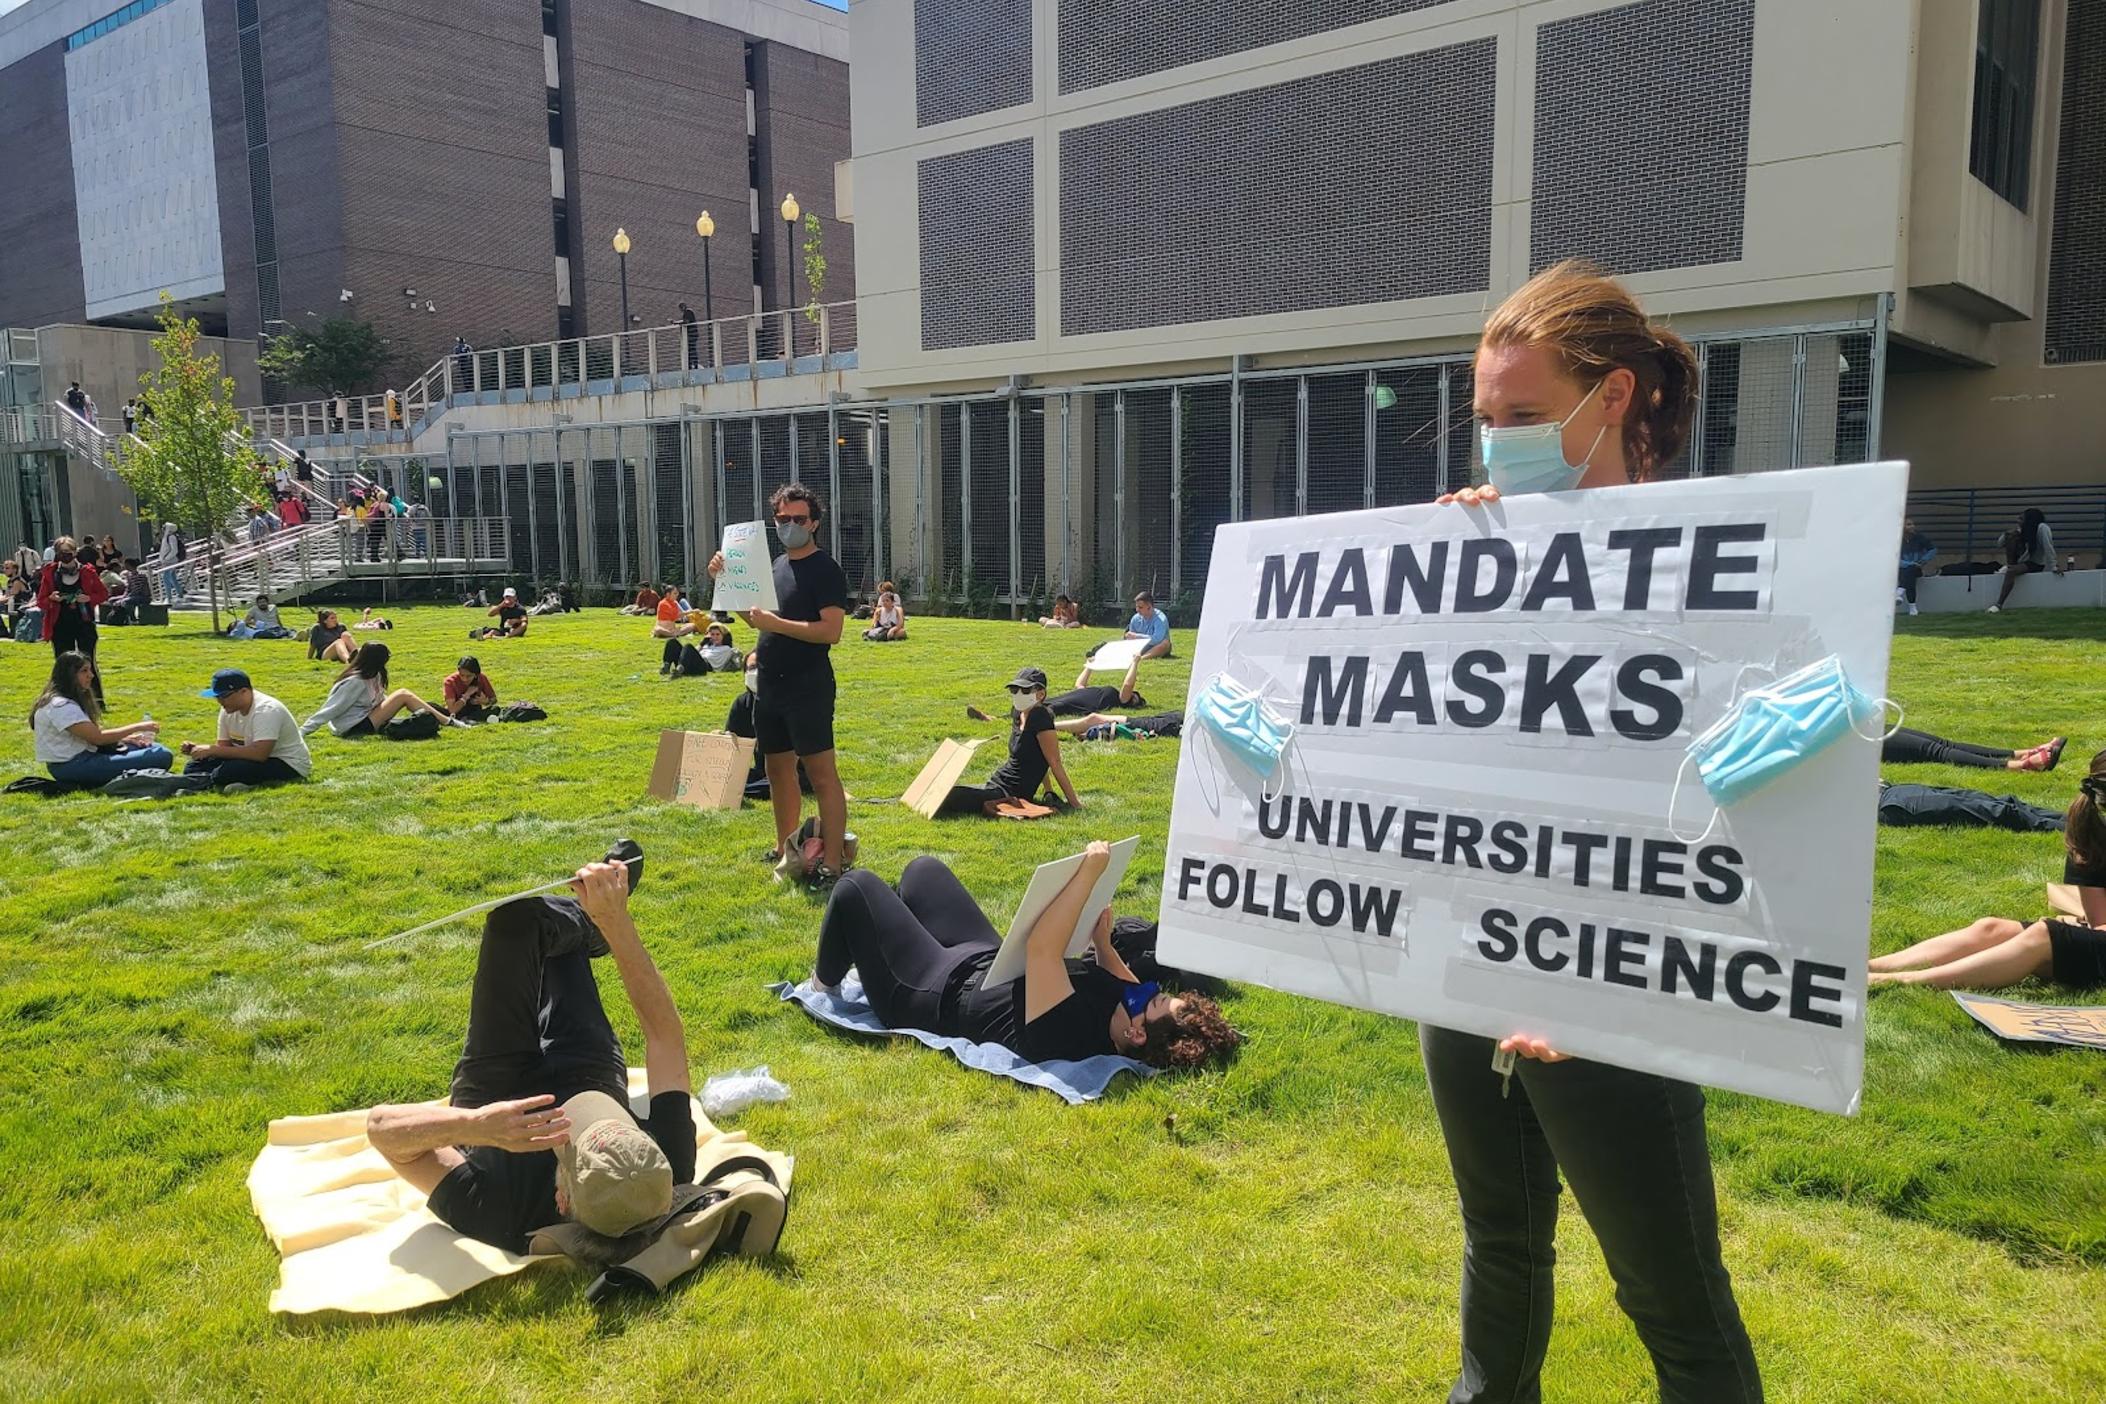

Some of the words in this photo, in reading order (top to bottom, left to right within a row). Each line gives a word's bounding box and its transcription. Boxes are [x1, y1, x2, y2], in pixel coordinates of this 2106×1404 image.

[1255, 523, 1767, 619] MANDATE
[1299, 649, 1685, 741] MASKS
[1257, 792, 1744, 905] UNIVERSITIES
[1177, 857, 1402, 938] FOLLOW
[1476, 908, 1847, 1028] SCIENCE
